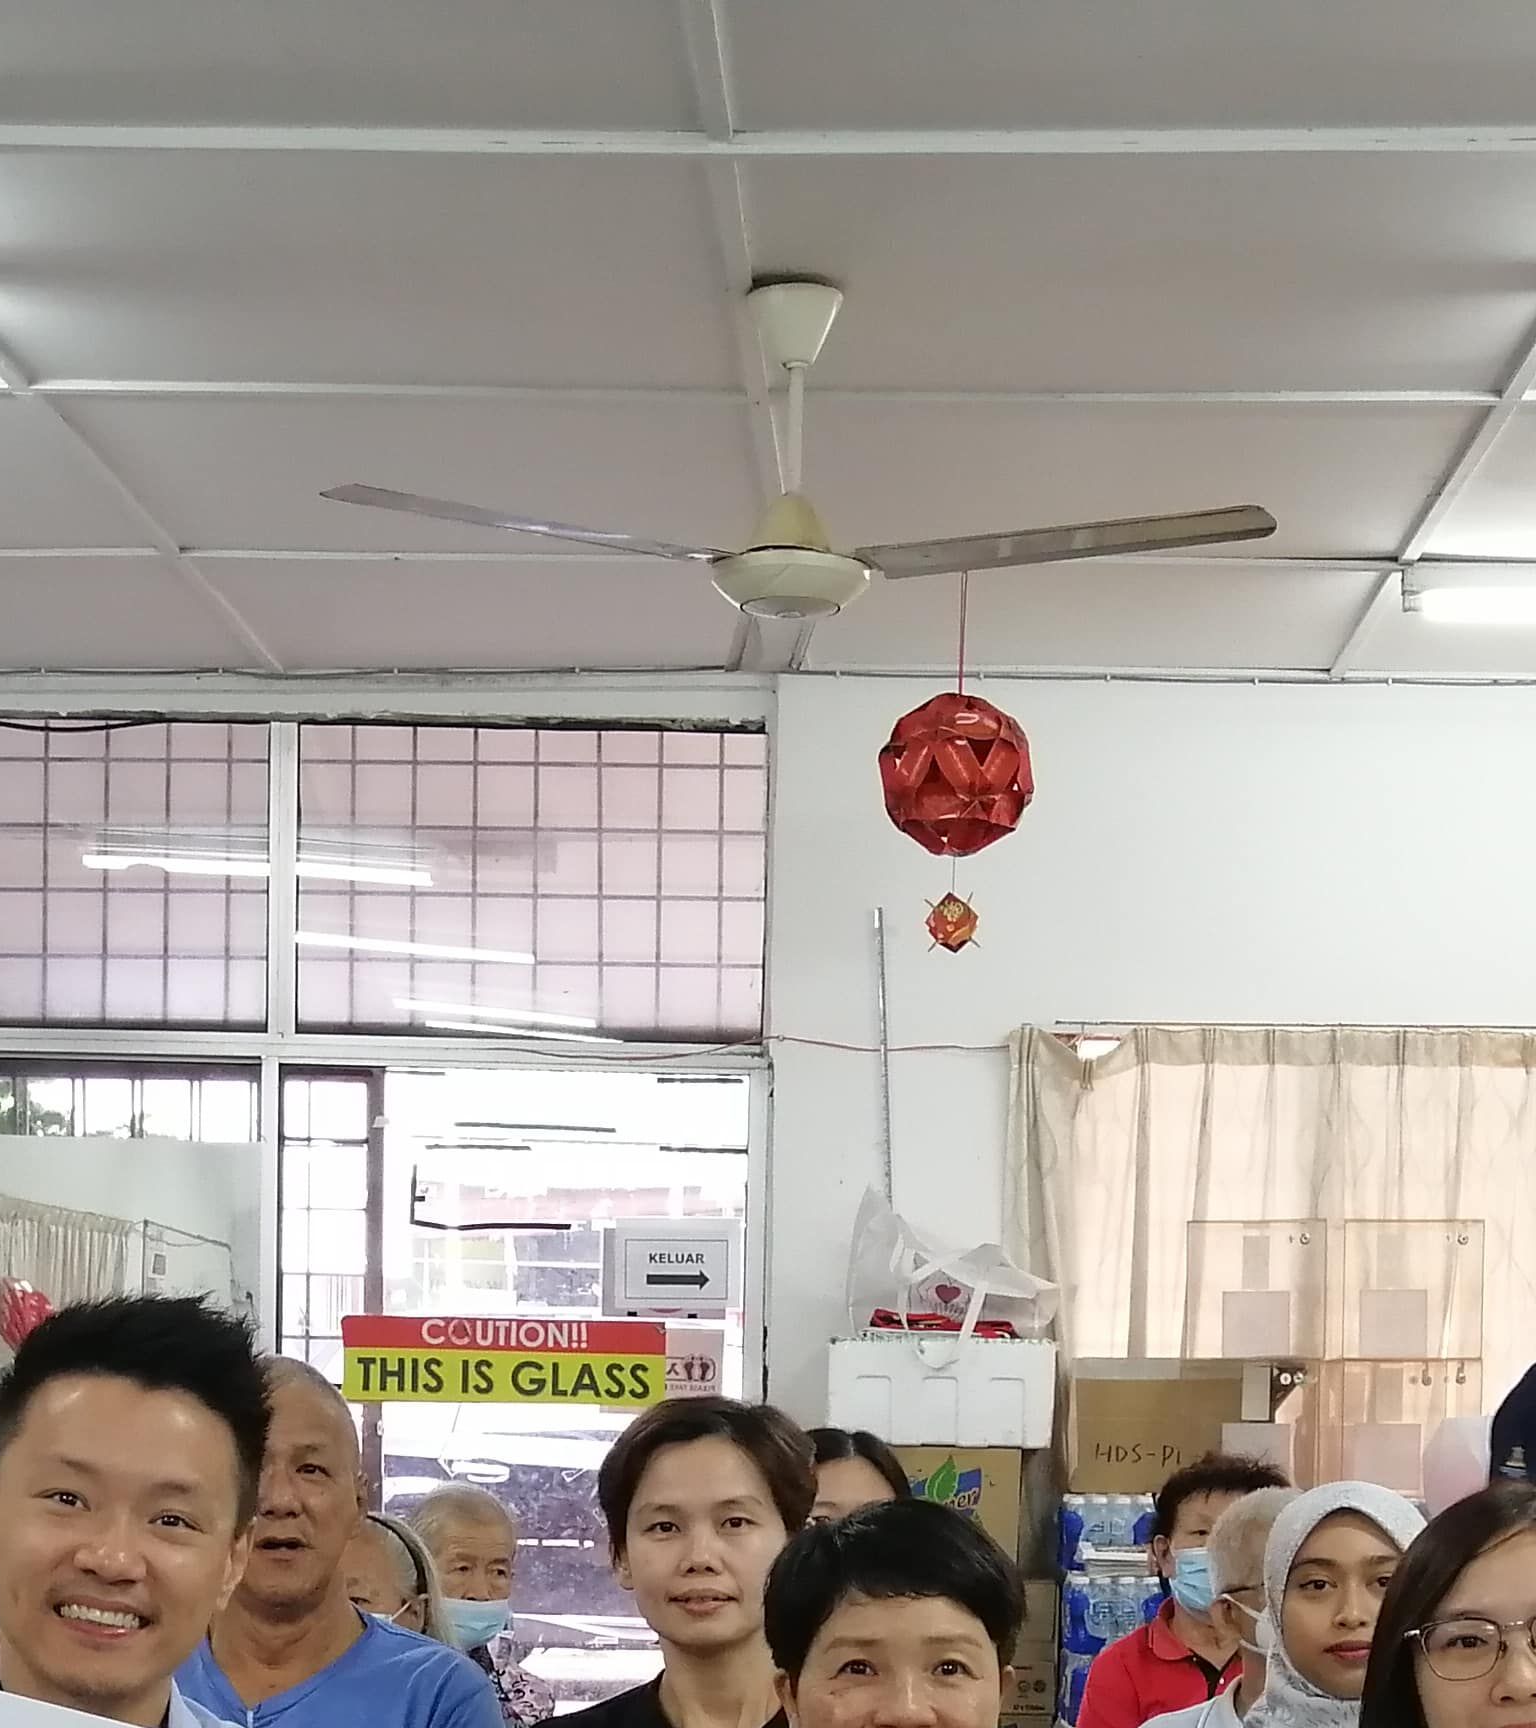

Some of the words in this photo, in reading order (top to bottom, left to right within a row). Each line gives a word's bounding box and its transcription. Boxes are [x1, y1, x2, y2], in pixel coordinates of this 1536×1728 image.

[648, 1252, 705, 1265] KELUAR
[357, 1356, 444, 1393] THIS
[462, 1359, 494, 1394] IS
[510, 1360, 651, 1399] GLASS
